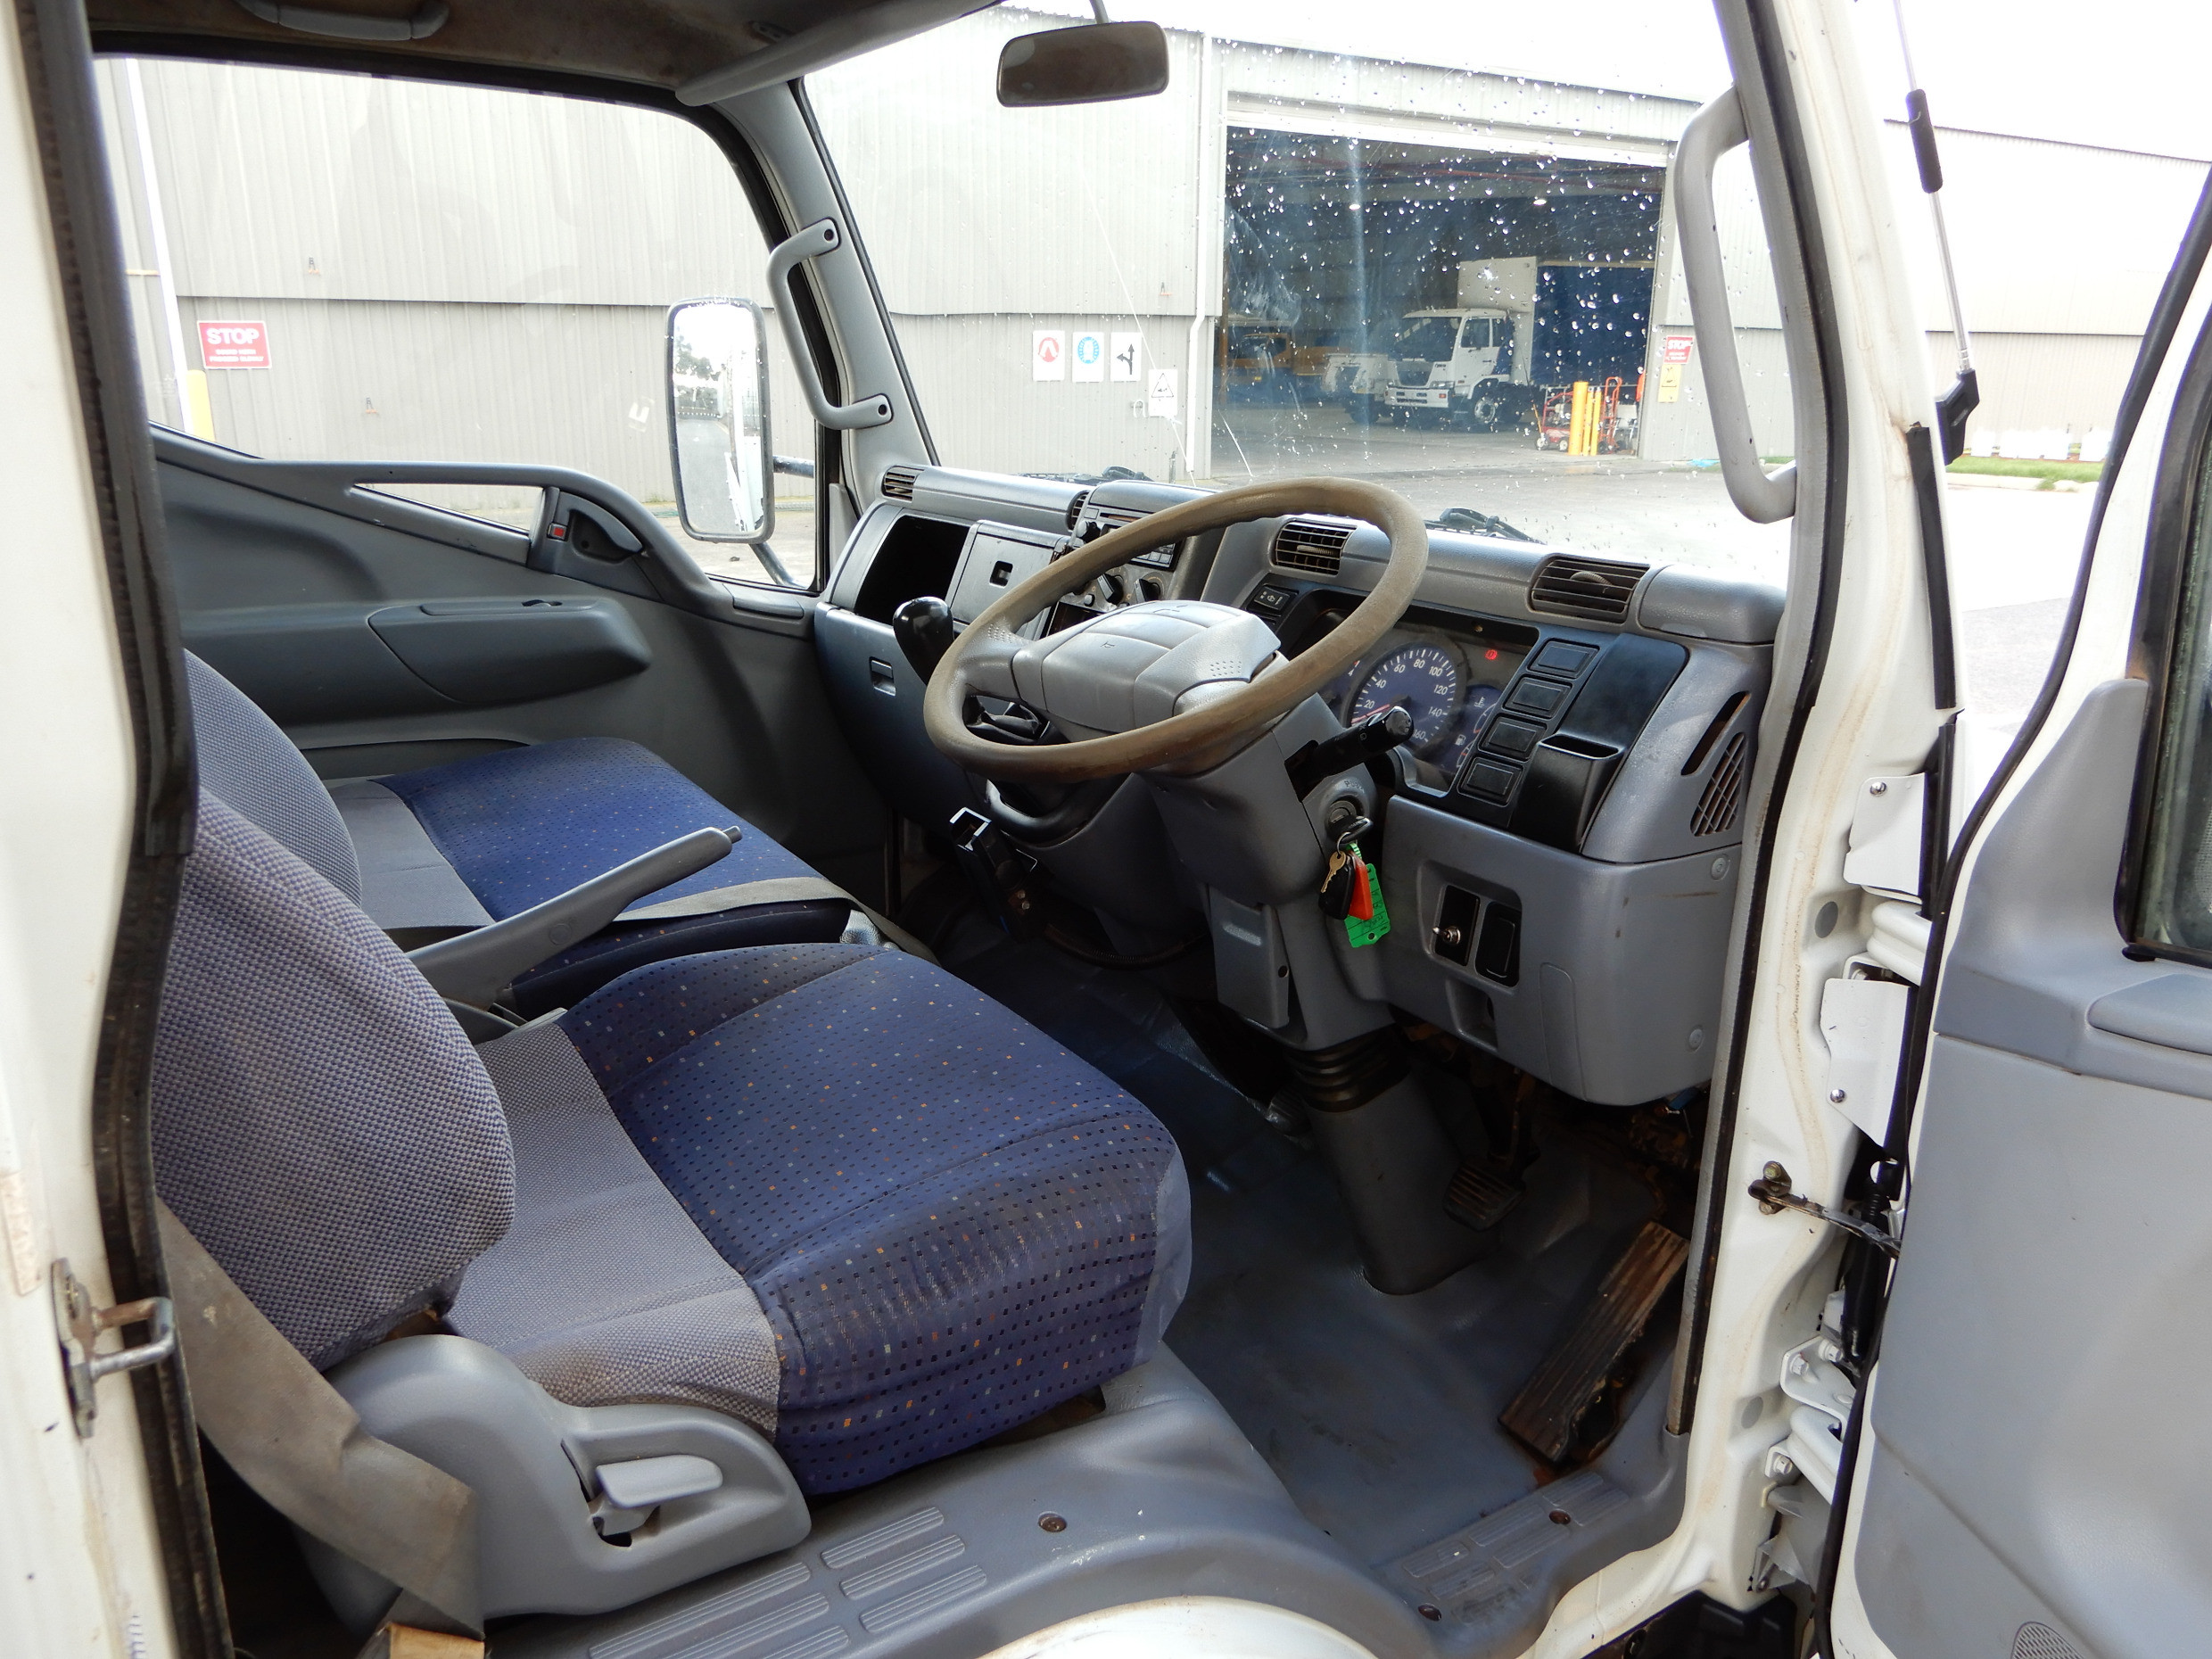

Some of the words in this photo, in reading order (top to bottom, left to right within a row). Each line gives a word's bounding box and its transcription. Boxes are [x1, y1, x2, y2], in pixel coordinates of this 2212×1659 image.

[206, 327, 260, 344] STOP
[1668, 340, 1691, 350] STOP
[1393, 664, 1406, 673] 60
[1413, 658, 1425, 669] 80
[1348, 669, 1354, 677] 4
[1429, 665, 1443, 677] 100
[1375, 678, 1387, 689] 40
[1433, 684, 1449, 696] 120
[1364, 699, 1375, 709] 20
[1428, 706, 1442, 716] 140
[1413, 729, 1426, 740] 160
